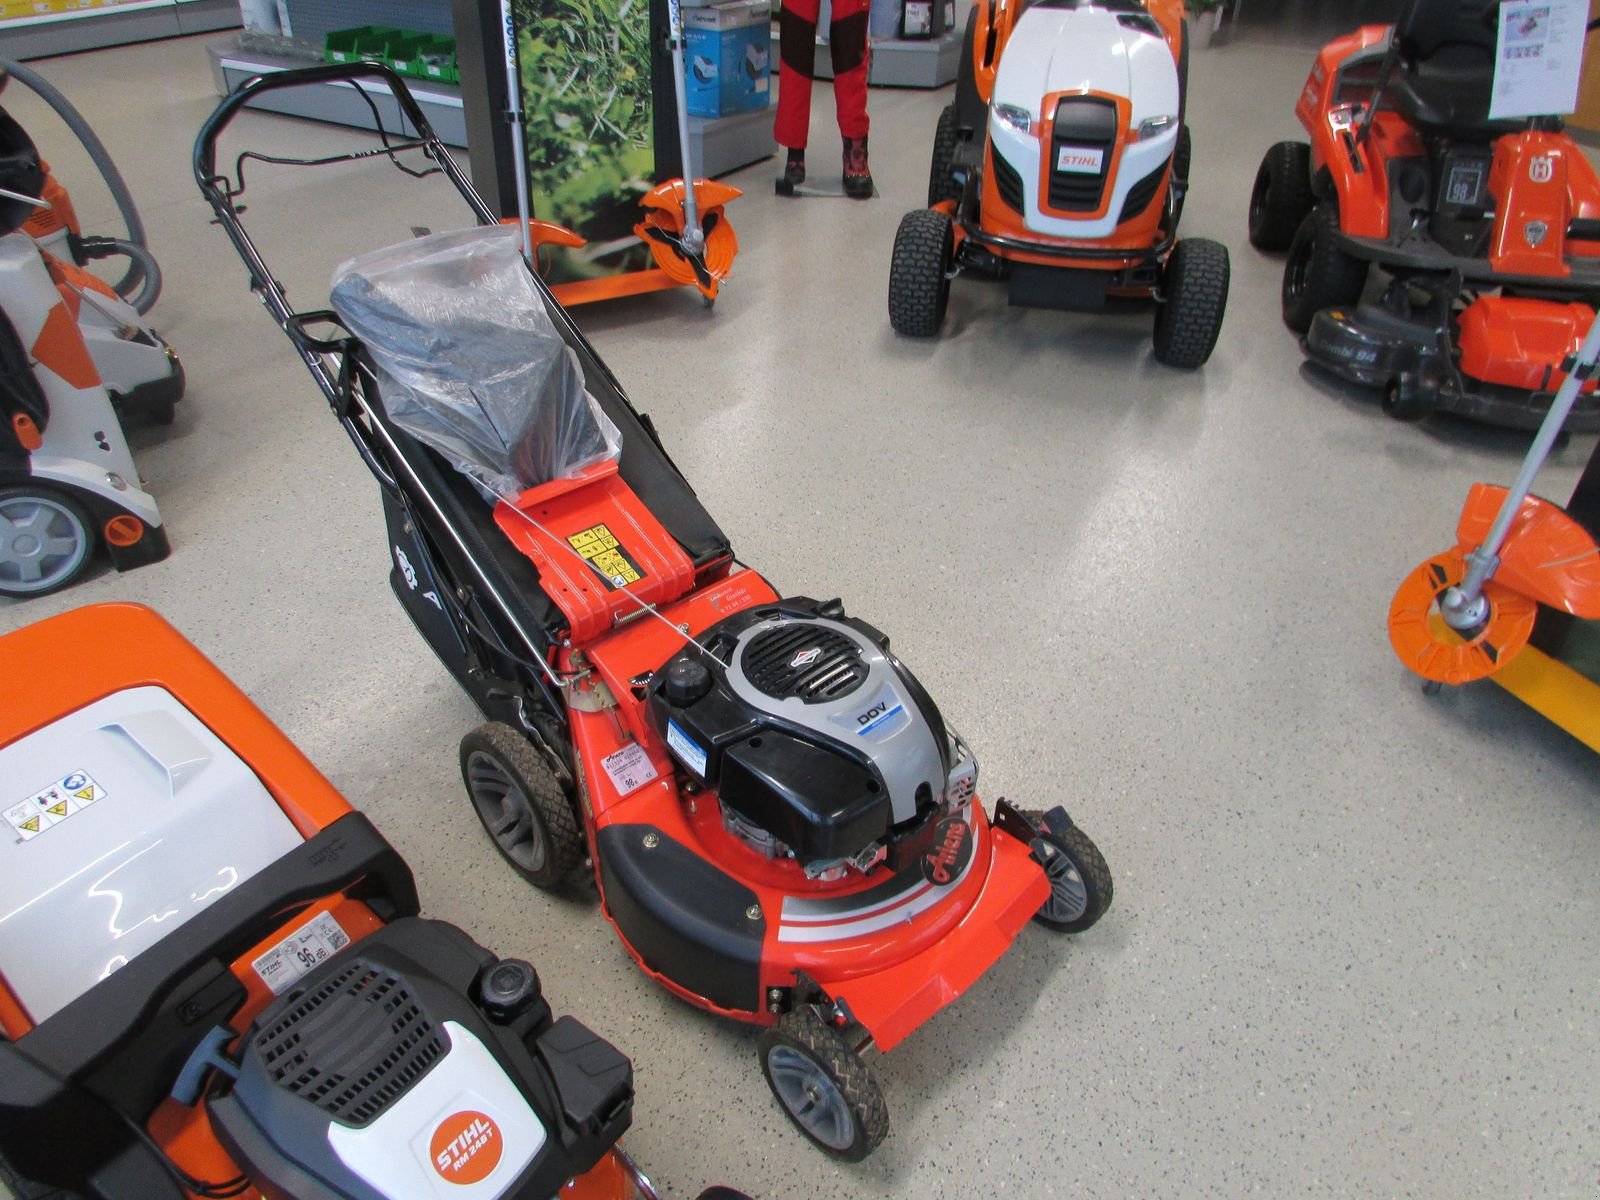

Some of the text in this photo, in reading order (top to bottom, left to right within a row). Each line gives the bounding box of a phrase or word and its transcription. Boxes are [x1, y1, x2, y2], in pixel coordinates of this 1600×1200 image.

[1062, 154, 1098, 167] STIHL
[1453, 183, 1468, 199] 98
[857, 701, 887, 725] DOV
[927, 823, 966, 882] Ariens
[261, 960, 282, 975] STIHL
[297, 947, 316, 968] 96
[315, 947, 327, 959] dB
[436, 1117, 490, 1172] STIHL
[453, 1127, 494, 1172] RM 248 T
